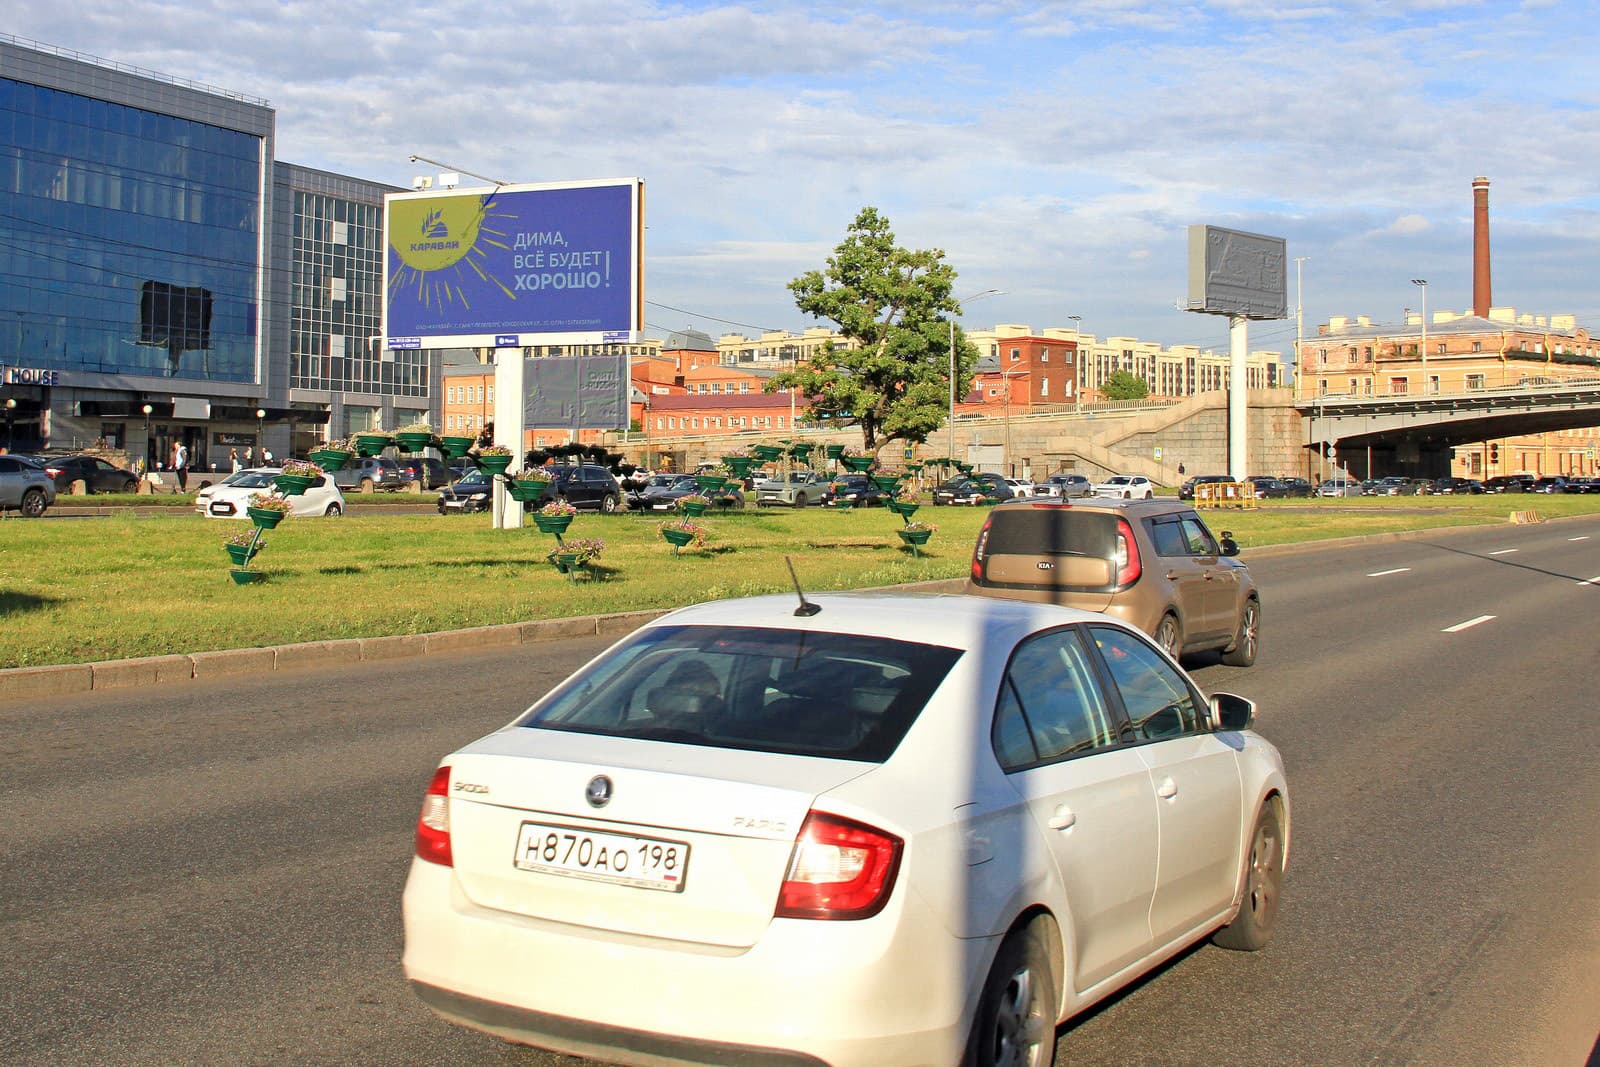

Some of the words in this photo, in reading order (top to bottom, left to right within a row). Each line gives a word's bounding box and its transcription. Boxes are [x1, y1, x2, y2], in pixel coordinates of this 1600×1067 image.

[513, 231, 568, 251] ДИМА,
[514, 250, 545, 269] ВСЁ
[549, 250, 602, 270] БУДЕТ
[11, 368, 59, 386] HOUSE
[638, 843, 677, 870] 198
